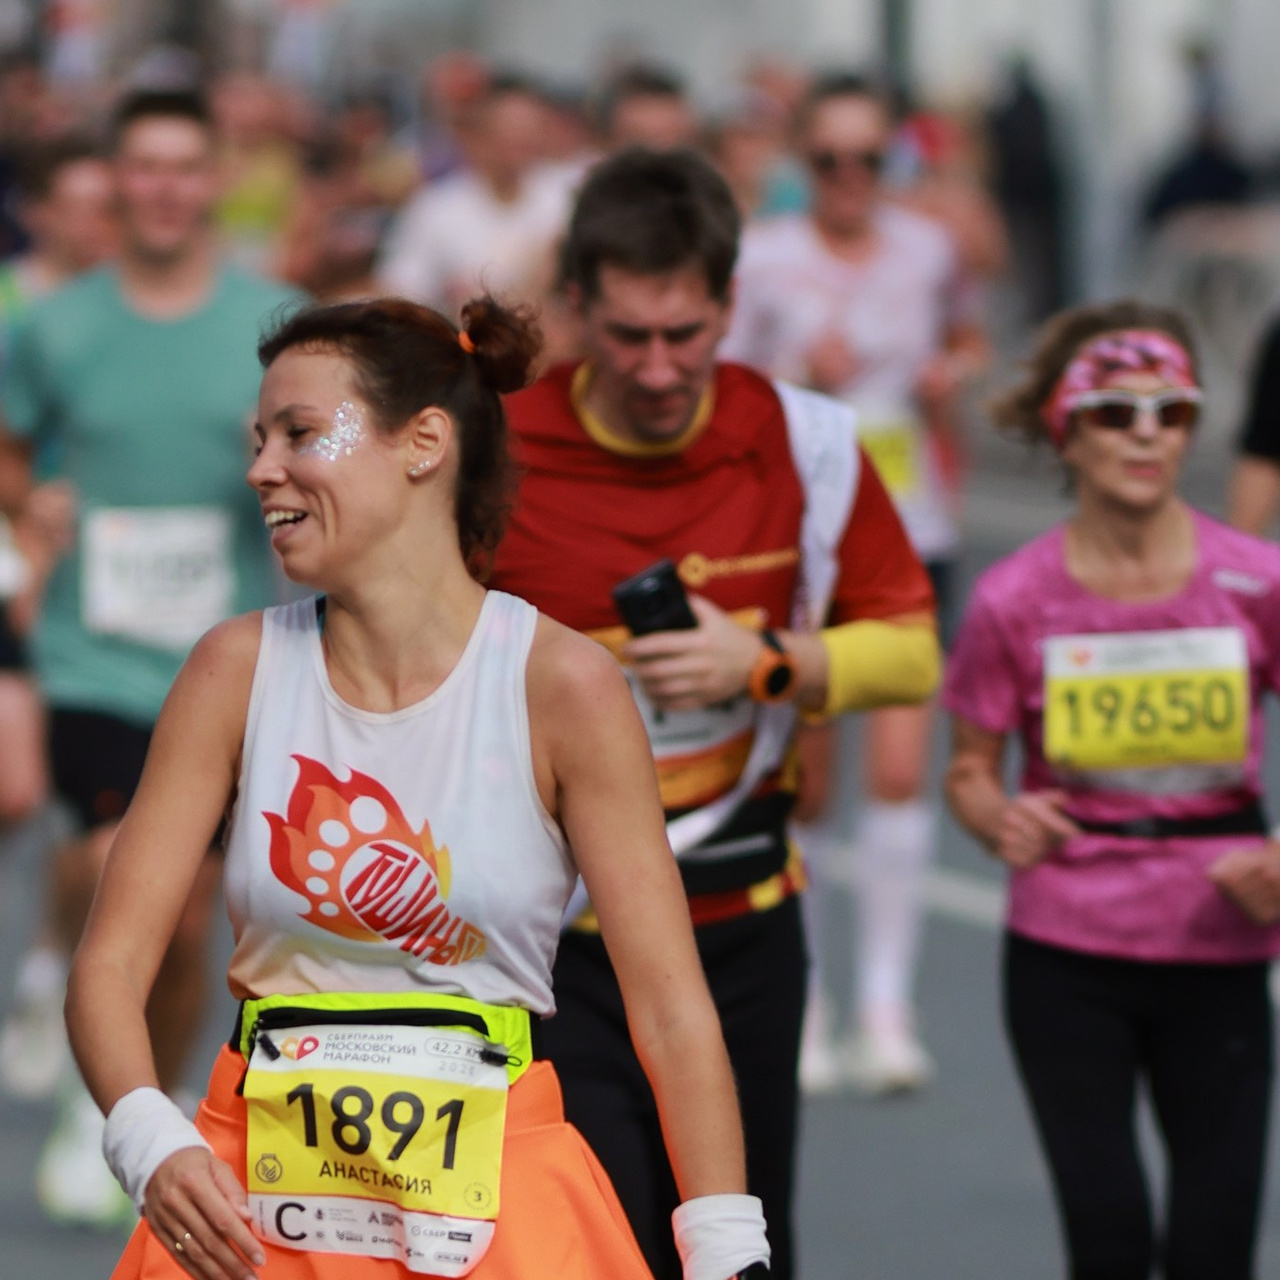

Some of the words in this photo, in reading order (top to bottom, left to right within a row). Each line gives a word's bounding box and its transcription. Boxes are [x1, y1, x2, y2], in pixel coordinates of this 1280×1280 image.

[1065, 678, 1235, 738] 19650
[323, 1052, 391, 1064] МАРАФОН
[324, 1041, 417, 1056] МОСКОВСКИЙ
[432, 1040, 462, 1055] 42,2
[286, 1083, 464, 1170] 1891
[319, 1160, 432, 1195] АНАСТАСИЯ
